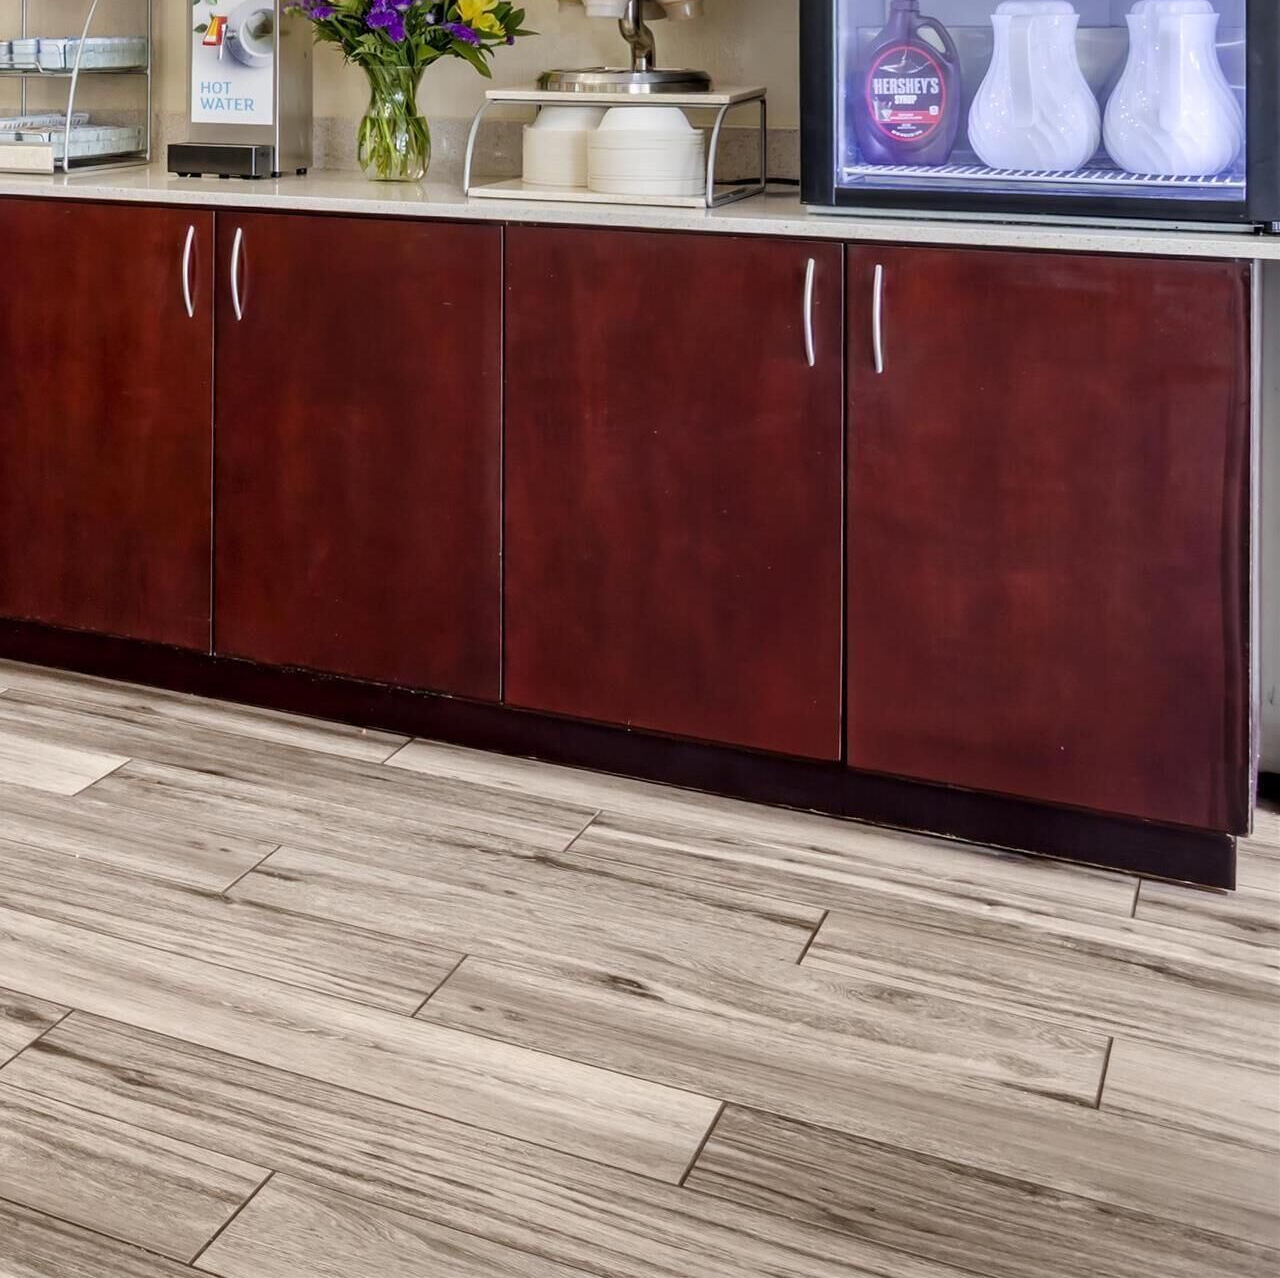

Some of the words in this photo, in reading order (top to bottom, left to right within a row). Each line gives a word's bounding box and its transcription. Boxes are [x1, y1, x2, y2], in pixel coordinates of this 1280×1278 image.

[200, 81, 232, 94] HOT
[873, 77, 939, 94] HERSHEY'S
[200, 97, 255, 111] WATER
